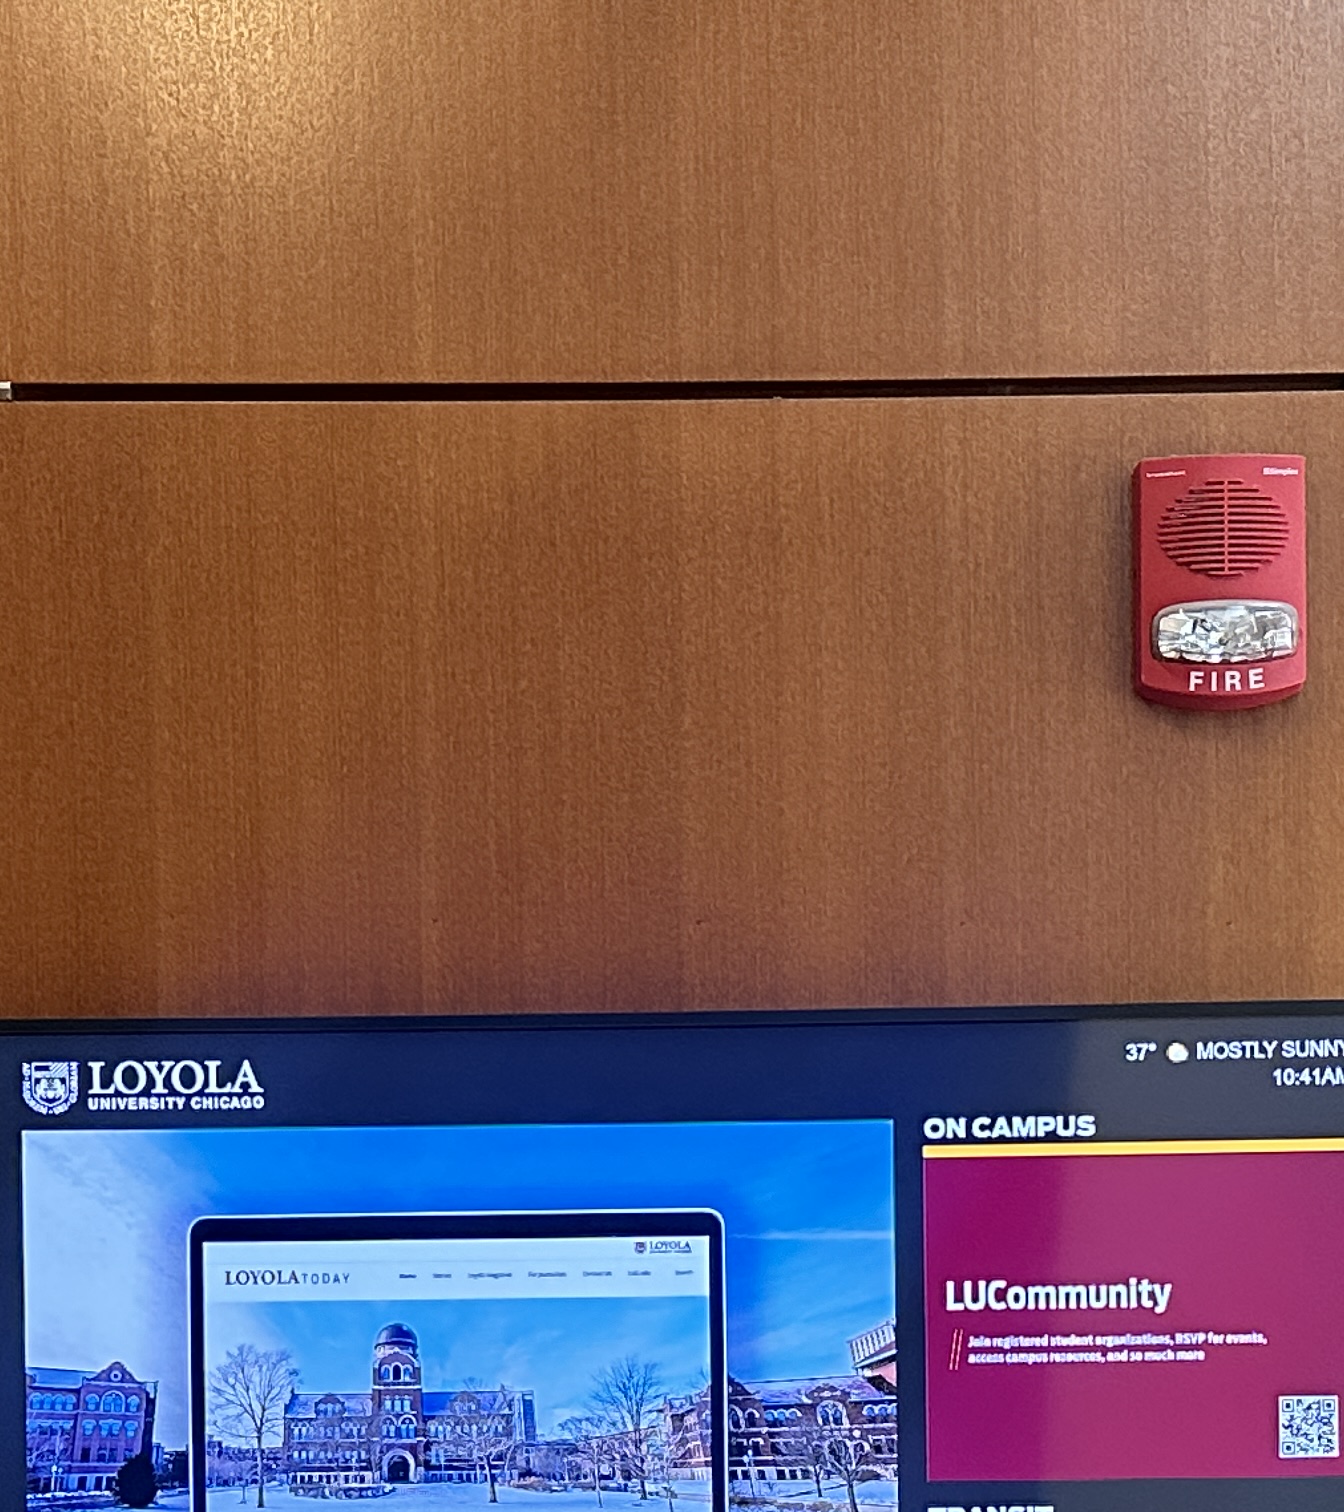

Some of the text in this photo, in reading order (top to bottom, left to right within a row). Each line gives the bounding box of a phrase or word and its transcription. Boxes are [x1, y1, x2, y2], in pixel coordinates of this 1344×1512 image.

[1188, 667, 1266, 692] FIRE
[1196, 1040, 1278, 1060] MOSTLY
[87, 1059, 264, 1094] LOYOLA
[88, 1096, 265, 1111] UNIVERSITY CHICAGO
[923, 1115, 1097, 1139] ON CAMPUS
[945, 1278, 1172, 1314] LUCommunity
[968, 1331, 1268, 1349] Join registered student organizations, RSVP for events,
[968, 1353, 1004, 1363] access
[1006, 1352, 1049, 1365] campus
[1106, 1350, 1128, 1361] and
[1129, 1351, 1143, 1361] so
[1144, 1349, 1175, 1361] much
[1176, 1350, 1205, 1361] more
